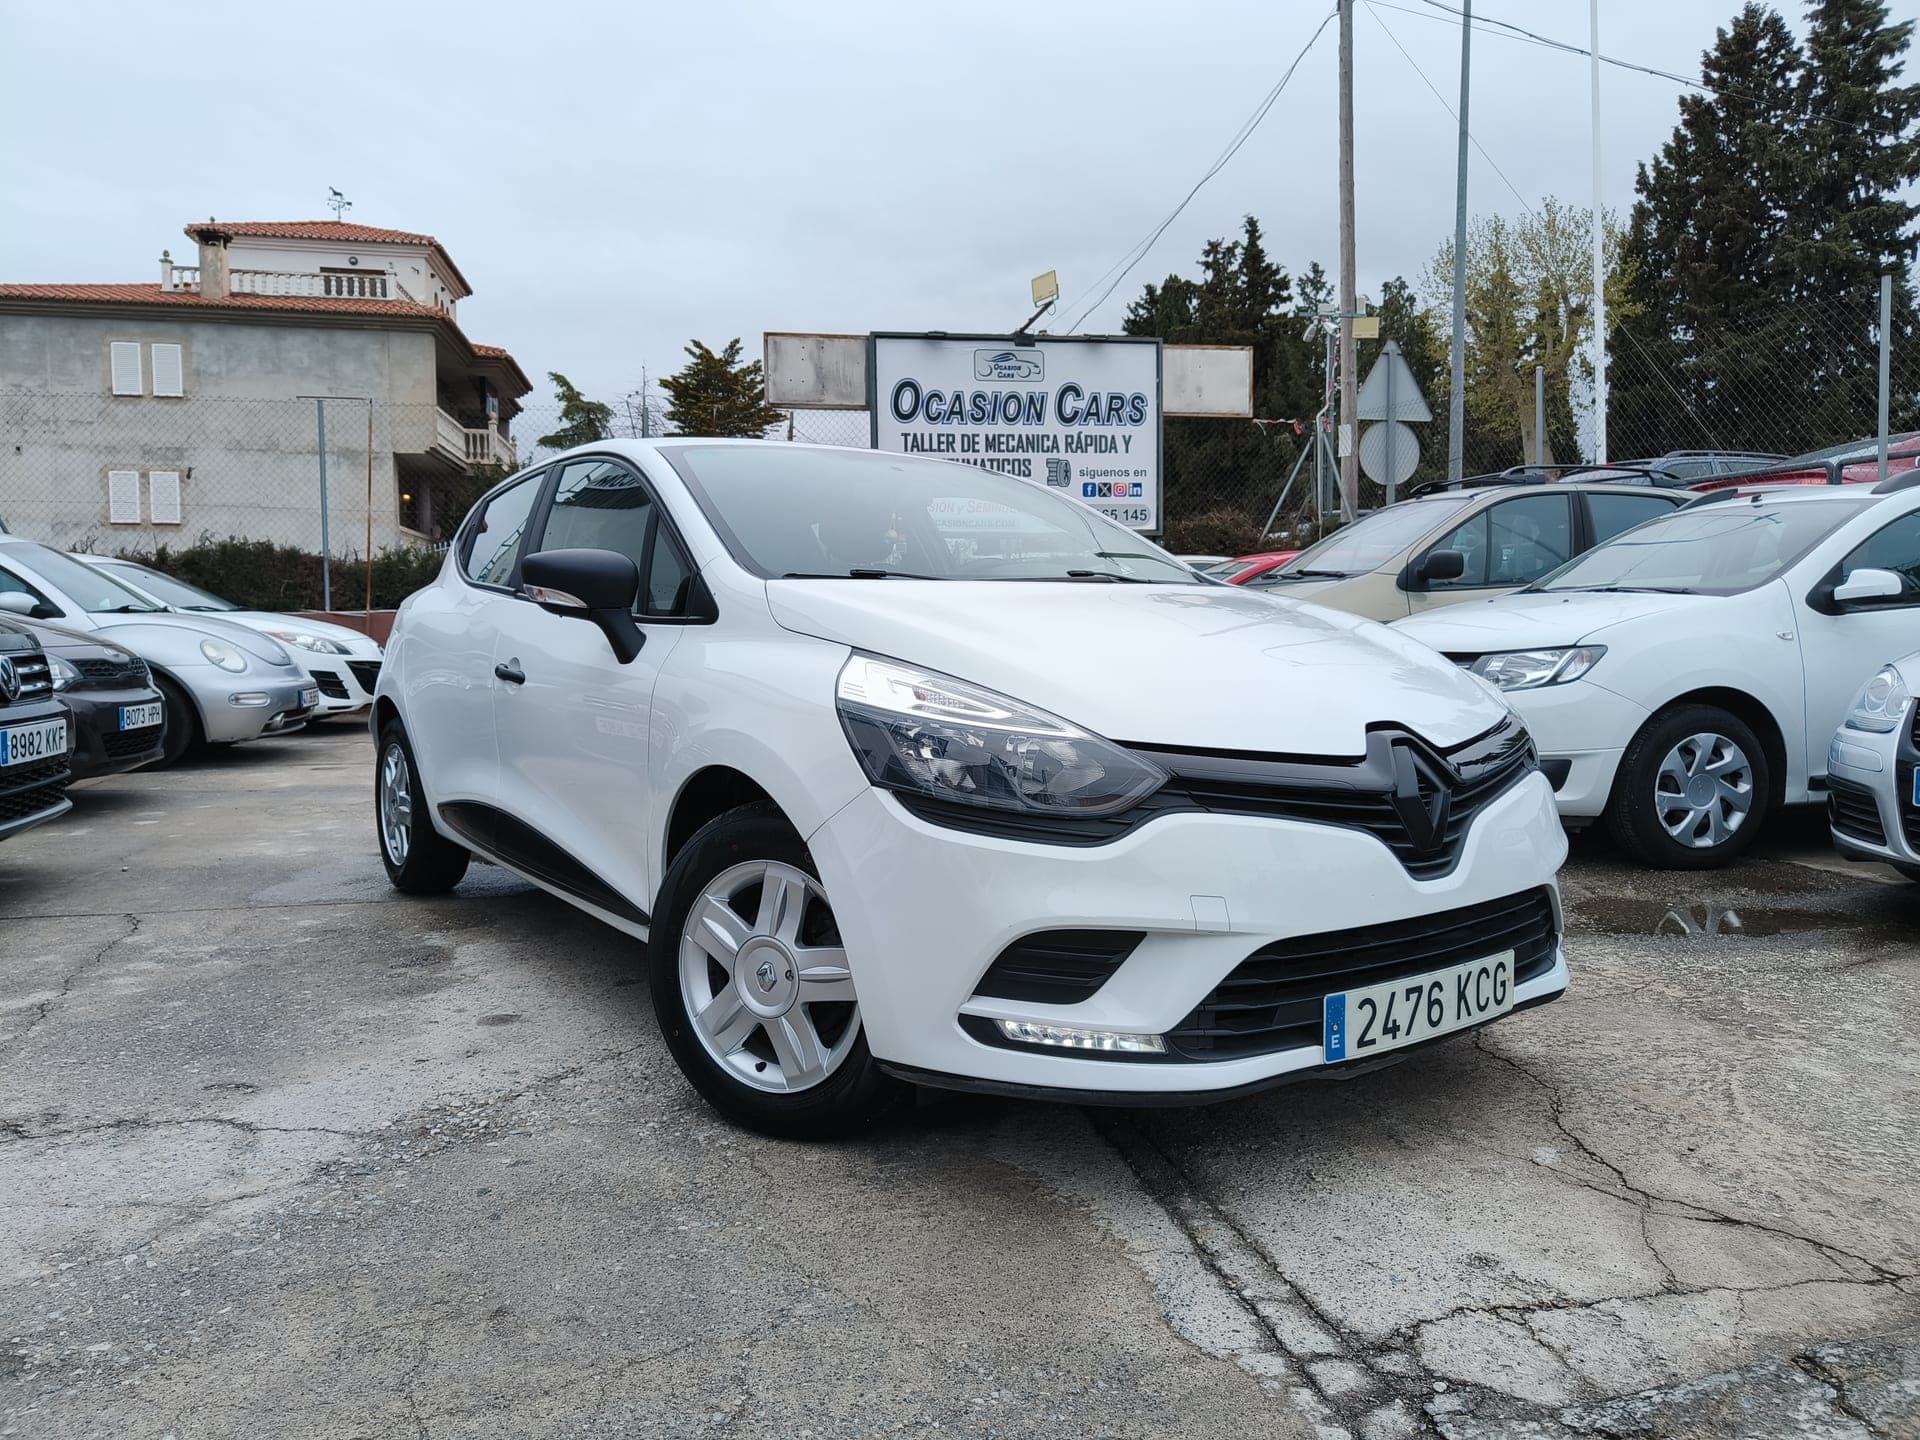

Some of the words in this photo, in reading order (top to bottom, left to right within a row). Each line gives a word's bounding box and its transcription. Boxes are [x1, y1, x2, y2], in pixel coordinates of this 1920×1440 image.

[890, 378, 1049, 426] OCASION
[1055, 382, 1149, 427] CARS
[901, 432, 956, 454] TALLER
[960, 433, 980, 454] DE
[984, 433, 1060, 454] MECANICA
[1064, 431, 1119, 454] RÁPIDA
[1121, 434, 1132, 454] Y
[1079, 467, 1130, 480] siguenos
[1133, 469, 1147, 477] en
[1122, 508, 1148, 521] 145
[125, 707, 146, 726] 8073
[10, 730, 43, 760] 8982
[45, 726, 65, 753] KKF
[1331, 1034, 1340, 1049] E
[1356, 980, 1444, 1049] 2476
[1456, 961, 1507, 1020] KCG
